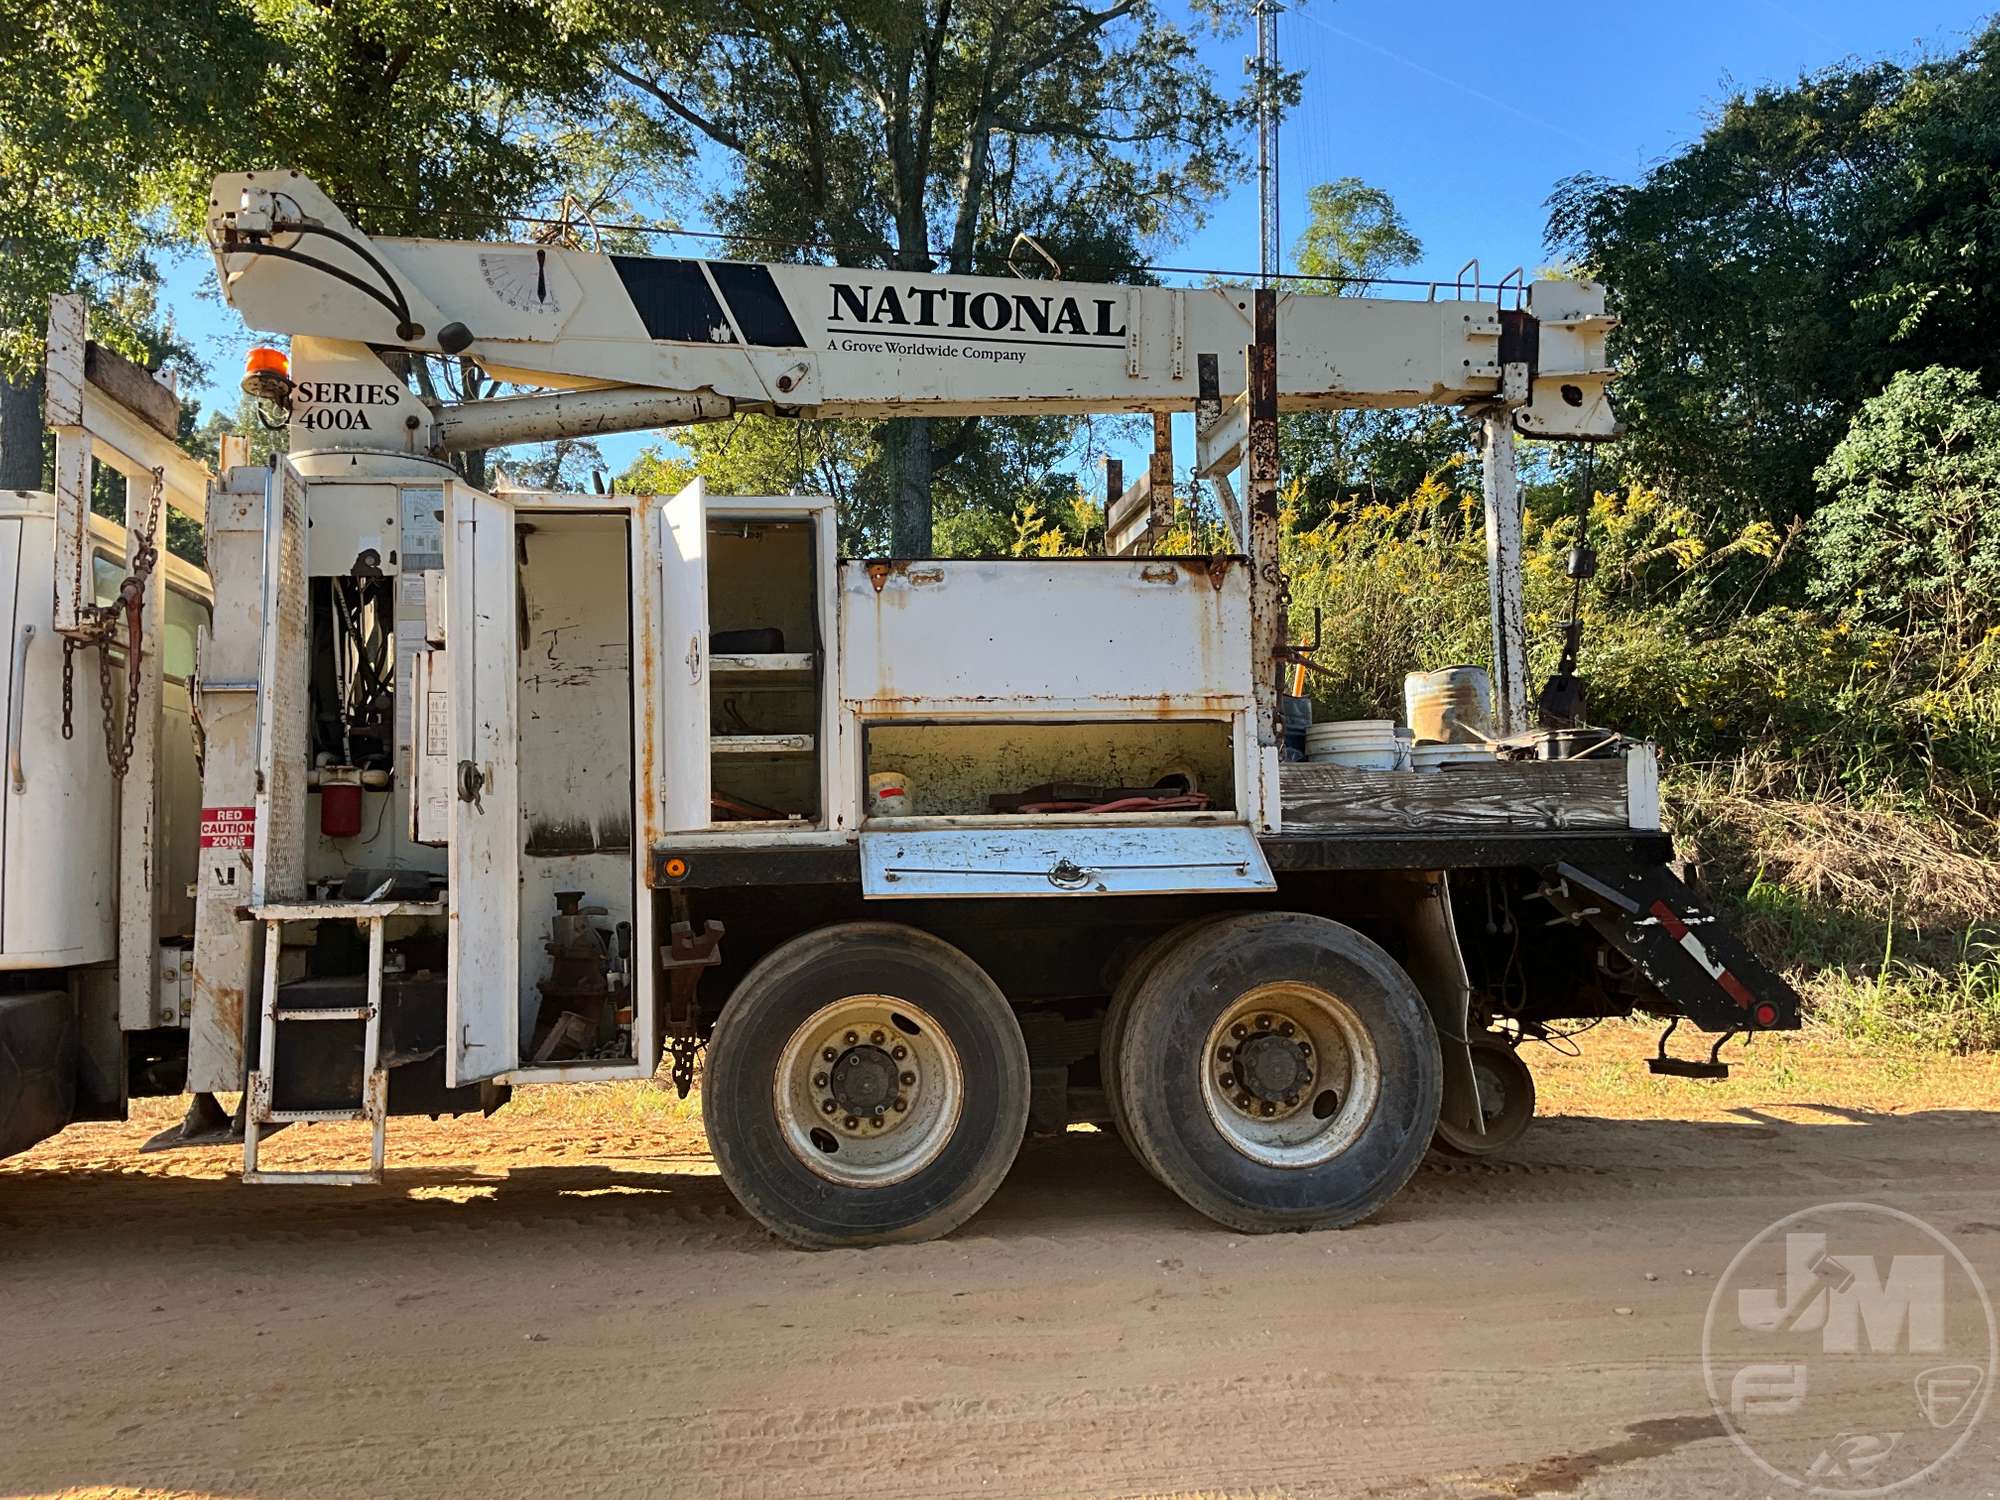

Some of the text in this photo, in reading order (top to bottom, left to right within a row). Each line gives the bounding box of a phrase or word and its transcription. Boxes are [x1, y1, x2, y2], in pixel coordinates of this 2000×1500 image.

[827, 283, 1126, 337] NATIONAL
[827, 339, 1026, 363] A Grove Worldwide Company
[297, 381, 400, 406] SERIES
[299, 406, 372, 432] 400A
[217, 810, 242, 821] RED
[202, 823, 254, 834] CAUTION
[212, 836, 246, 847] ZONE
